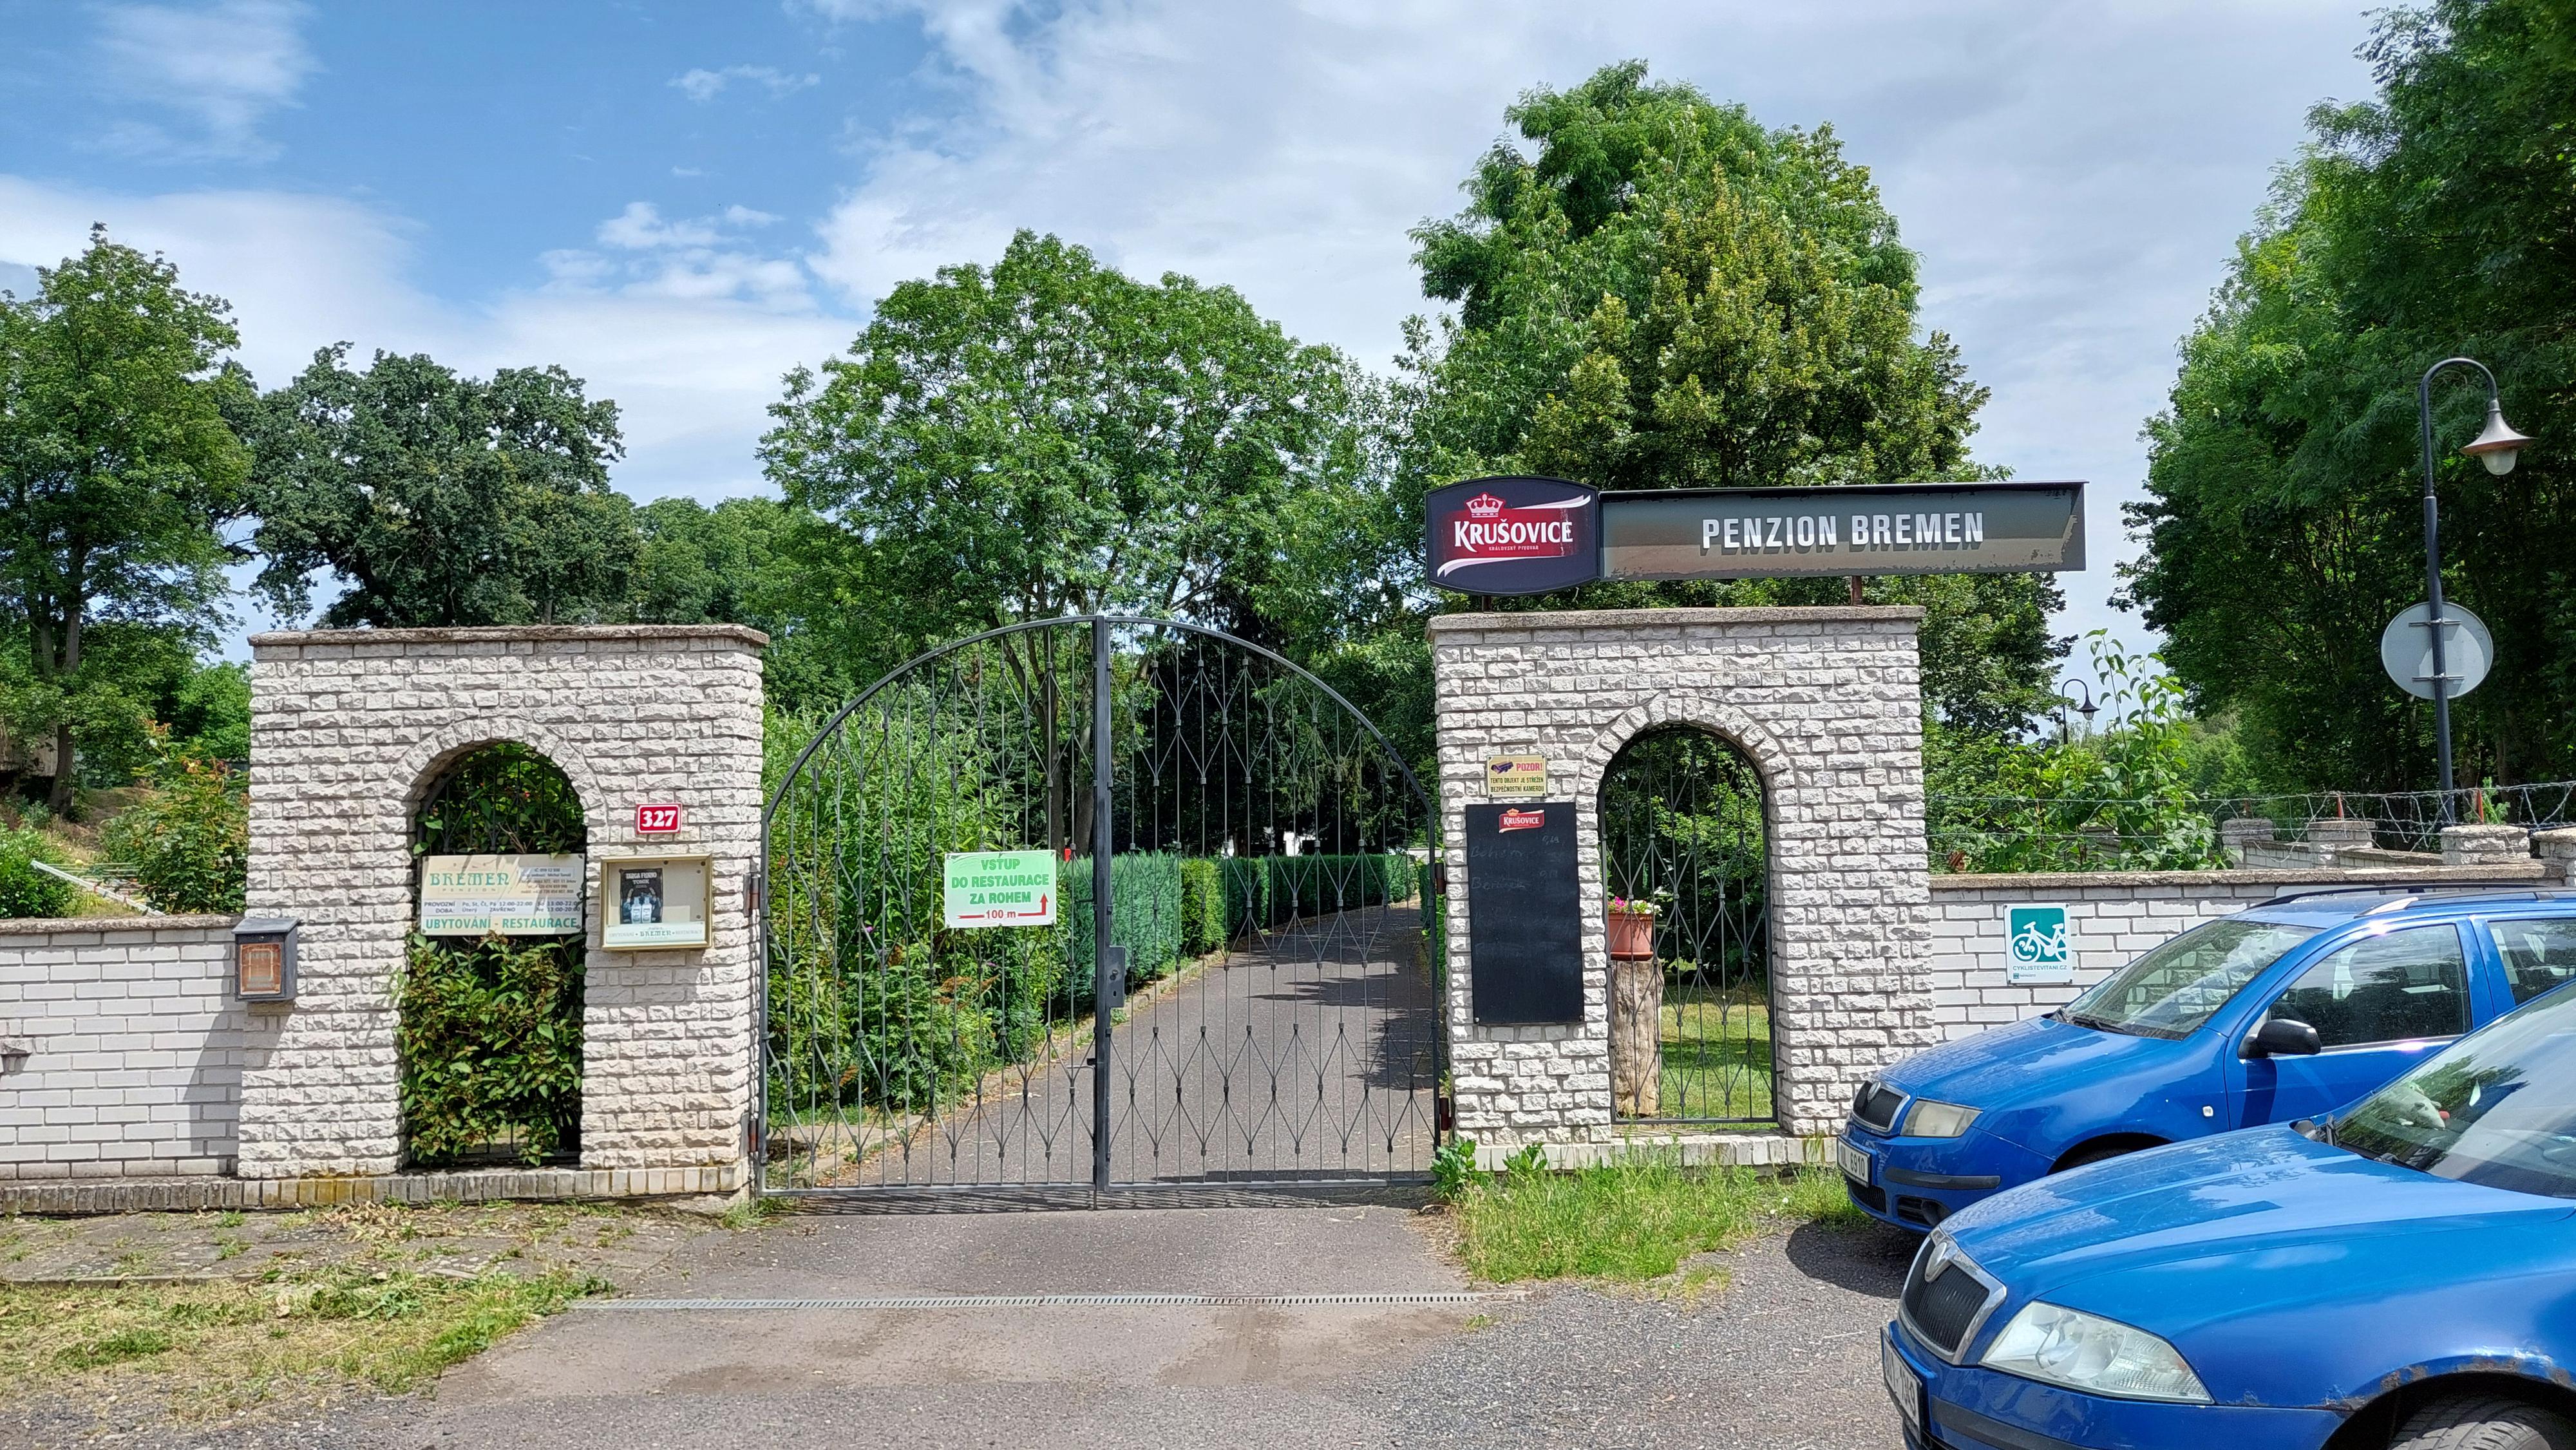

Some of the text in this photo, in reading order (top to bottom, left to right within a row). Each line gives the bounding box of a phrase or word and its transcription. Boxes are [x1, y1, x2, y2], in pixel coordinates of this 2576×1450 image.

[1702, 513, 1983, 549] PENZION BREMEN
[1516, 762, 1543, 771] POZOR!
[641, 810, 676, 827] 327
[981, 858, 1021, 871] VSTUP
[430, 872, 509, 885] BREMEN
[951, 874, 1050, 889] DO RESTAURACE
[969, 891, 1031, 905] ZA ROHEM
[986, 910, 1004, 919] 100
[426, 916, 491, 928] UBYTOVÁNÍ
[502, 918, 578, 928] RESTAURACE
[1850, 1152, 1865, 1178] 6910
